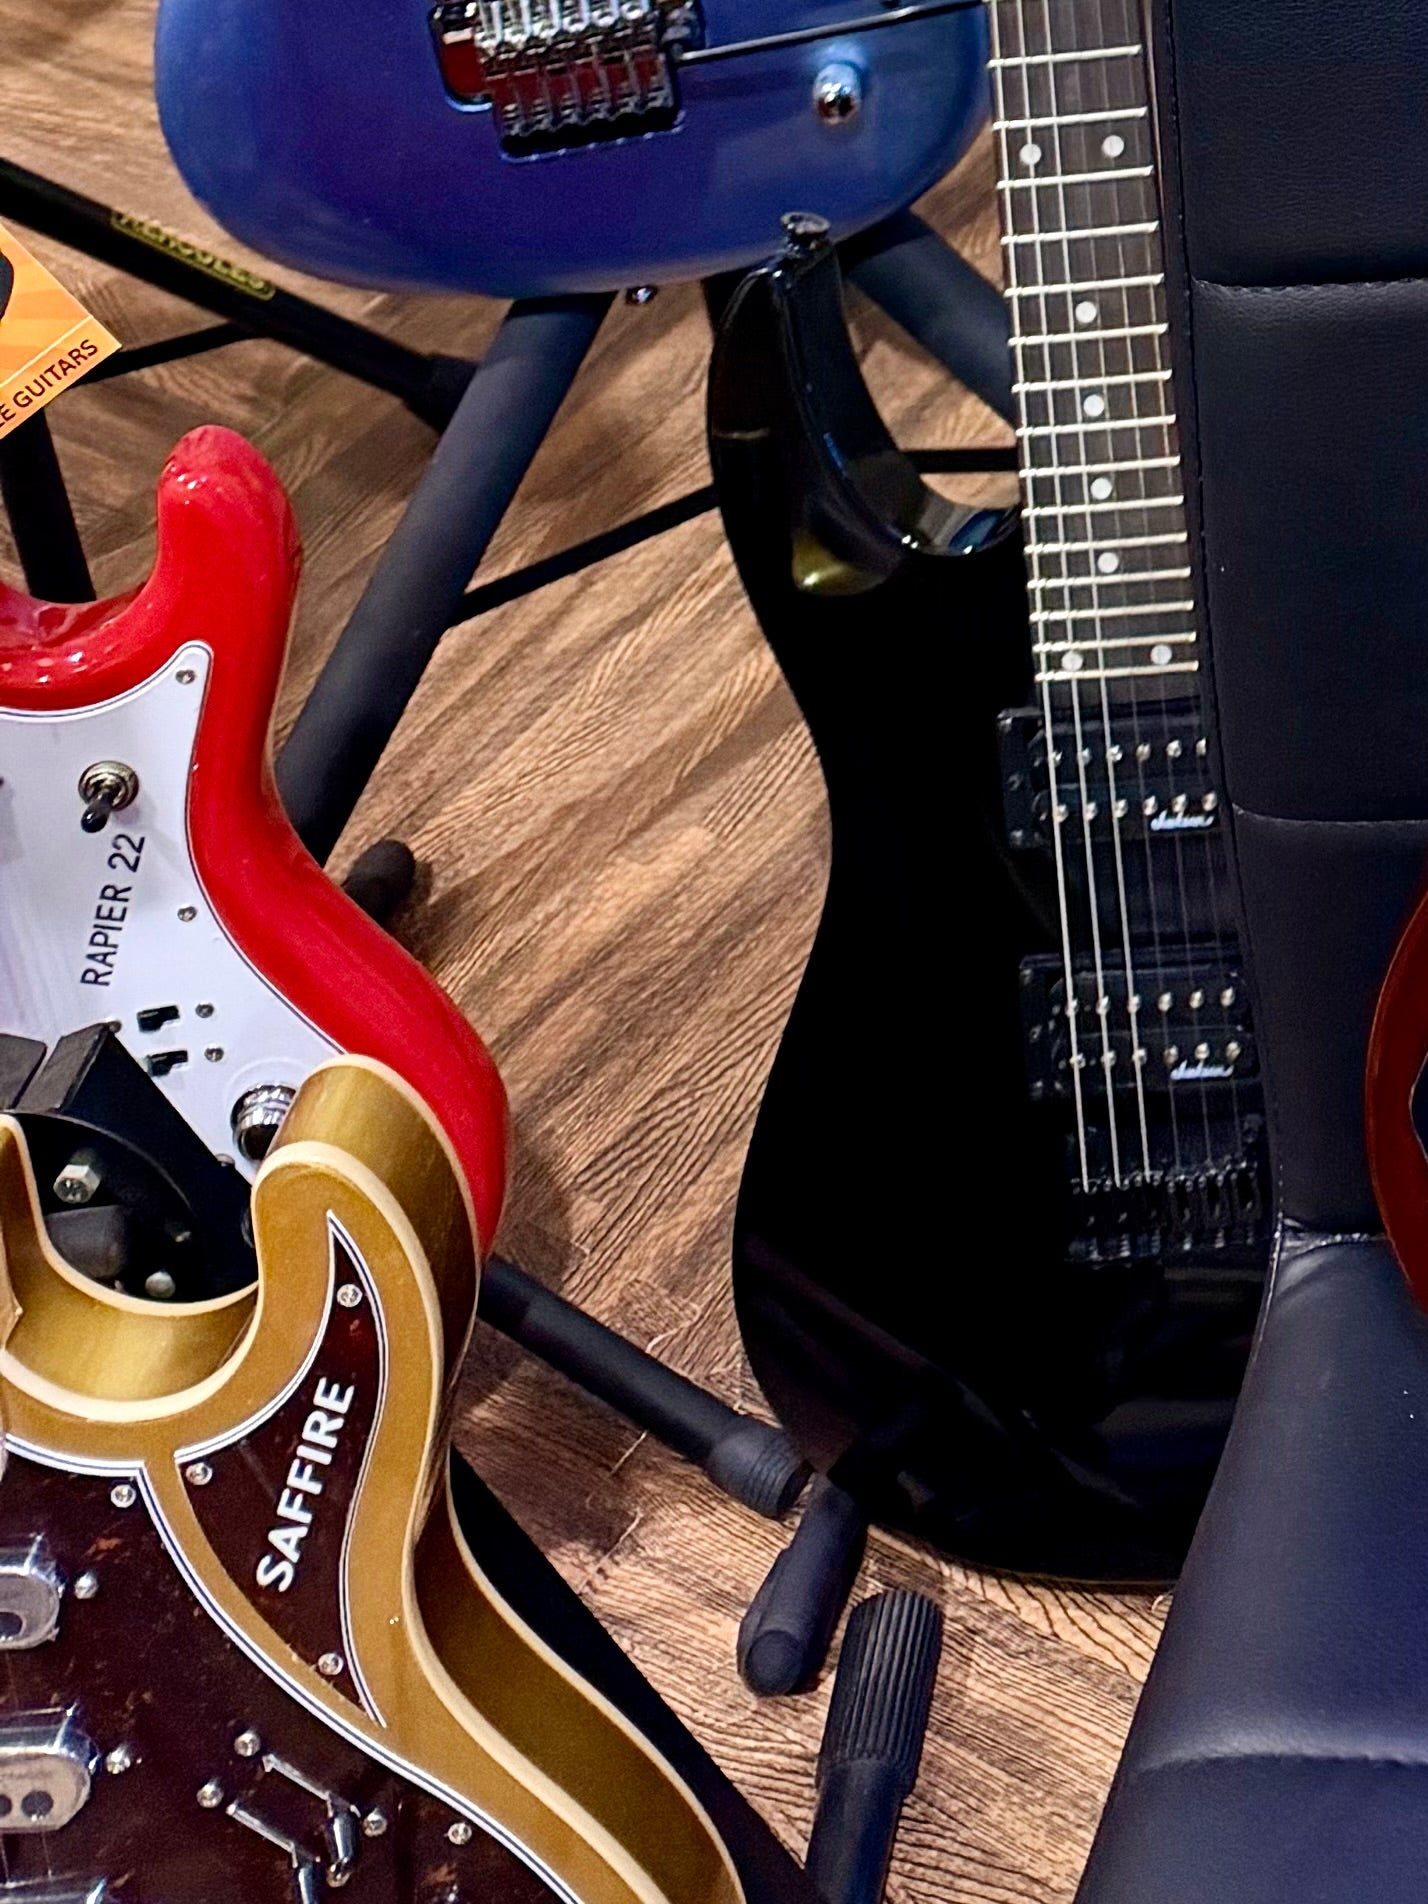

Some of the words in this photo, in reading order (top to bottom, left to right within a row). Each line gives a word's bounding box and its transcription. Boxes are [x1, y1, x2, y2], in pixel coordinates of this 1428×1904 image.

[12, 338, 99, 408] GUITARS
[79, 883, 134, 987] RAPIER
[107, 833, 146, 873] 22
[255, 1376, 356, 1593] SAFFIRE
